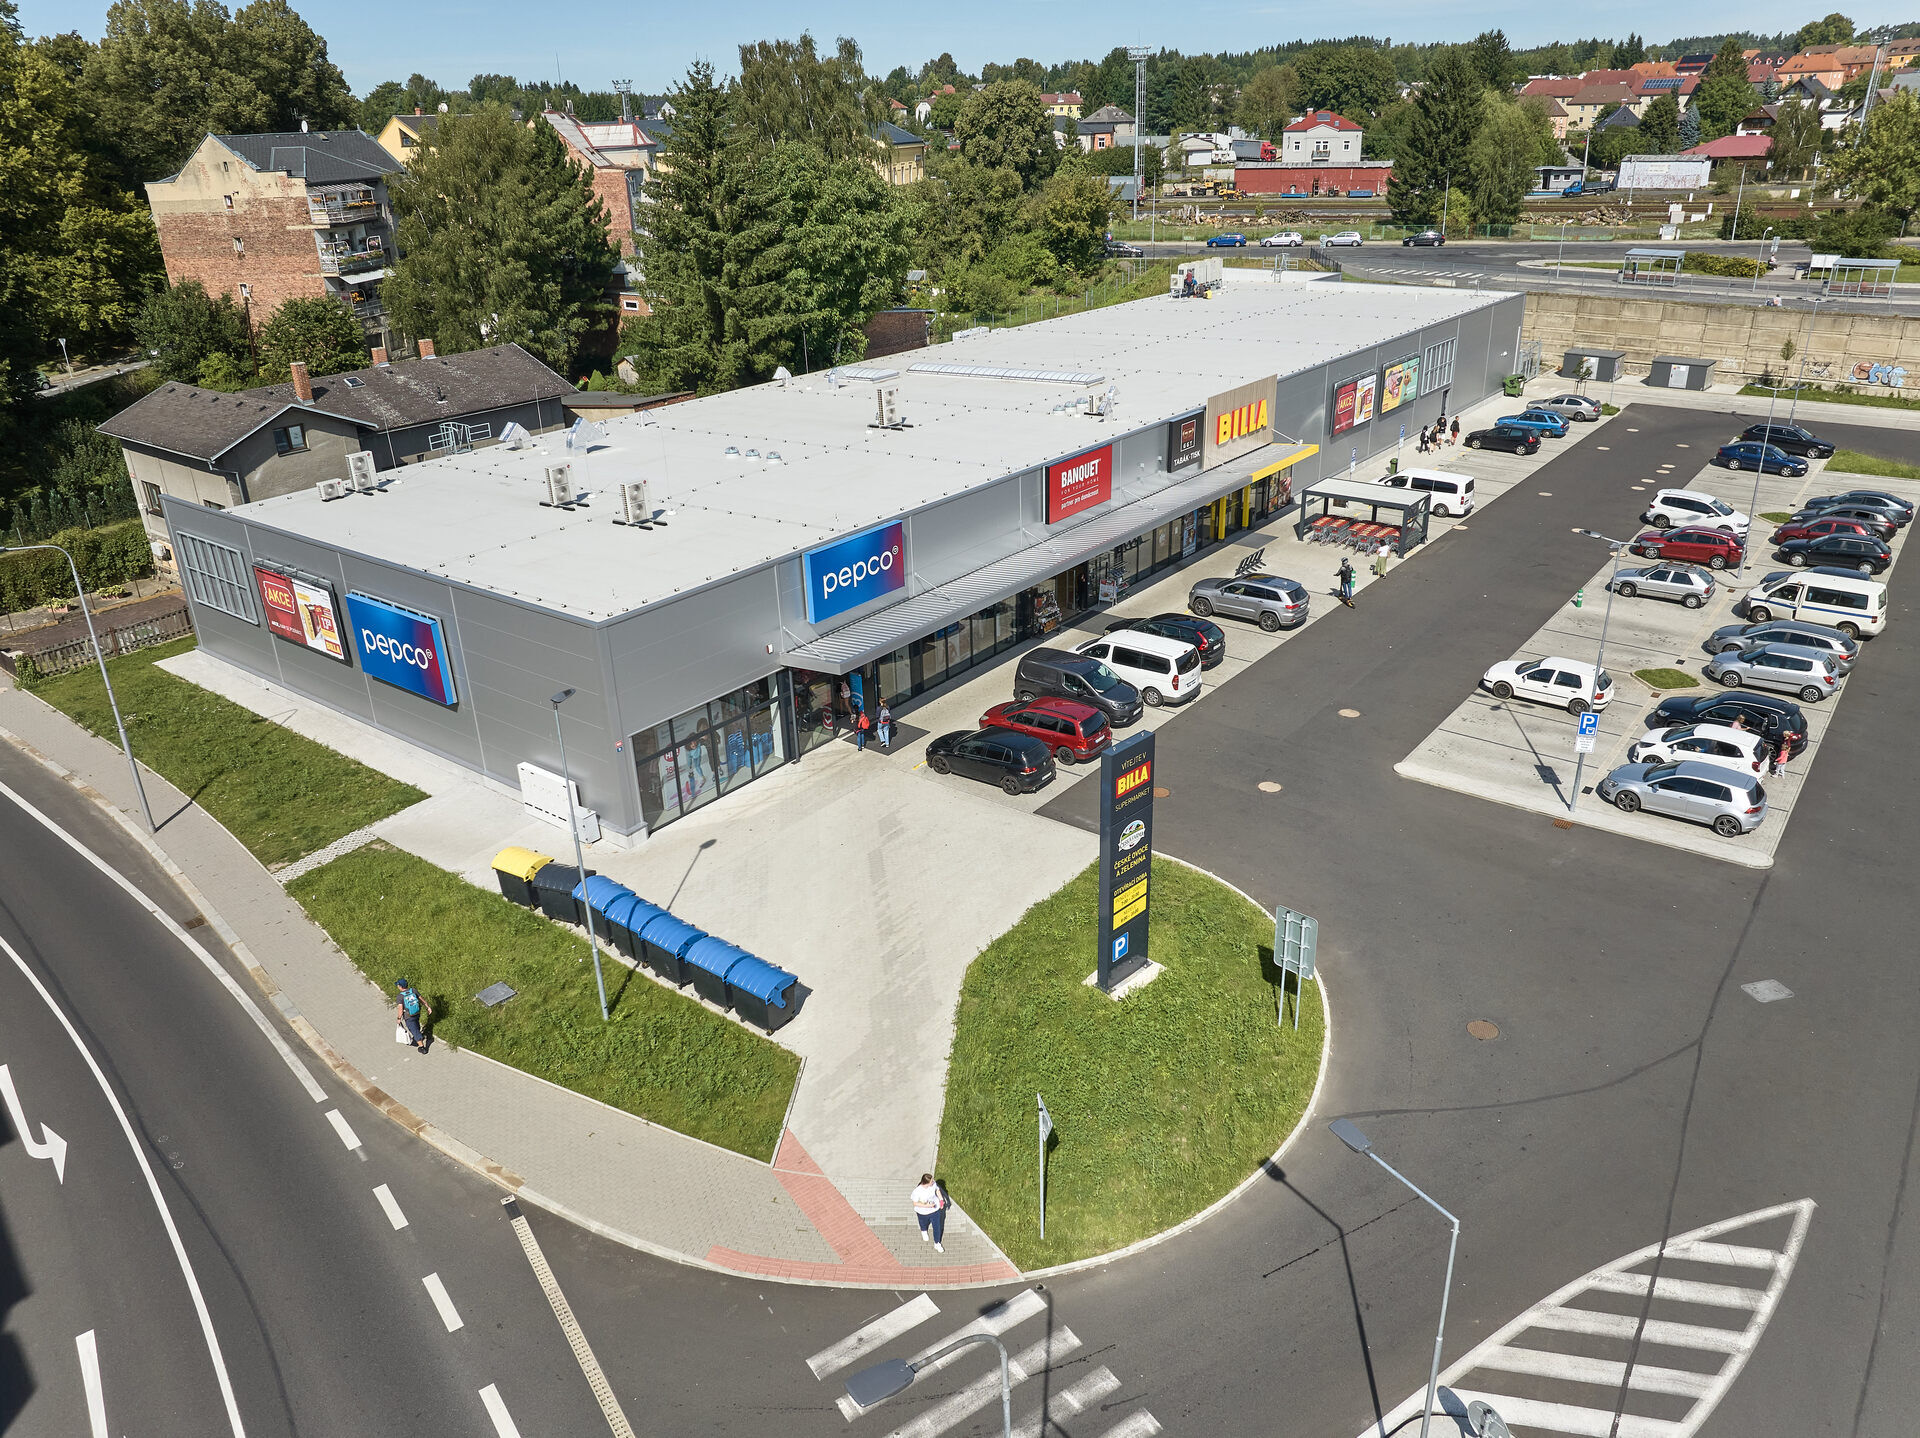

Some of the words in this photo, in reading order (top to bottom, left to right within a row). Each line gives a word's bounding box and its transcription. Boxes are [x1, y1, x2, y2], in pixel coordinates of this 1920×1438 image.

[1216, 399, 1268, 446] BILLA
[1061, 458, 1100, 488] BANQUET
[268, 588, 292, 608] AKCE
[1582, 715, 1595, 729] P
[1121, 754, 1142, 770] VÍTEJTE
[1117, 765, 1148, 795] BILLA
[1115, 787, 1150, 812] SUPERMARKET
[1113, 853, 1131, 870] ČESKÉ
[1131, 844, 1148, 859] OVOCE
[1120, 854, 1146, 875] ZELENINA
[1114, 936, 1125, 959] P
